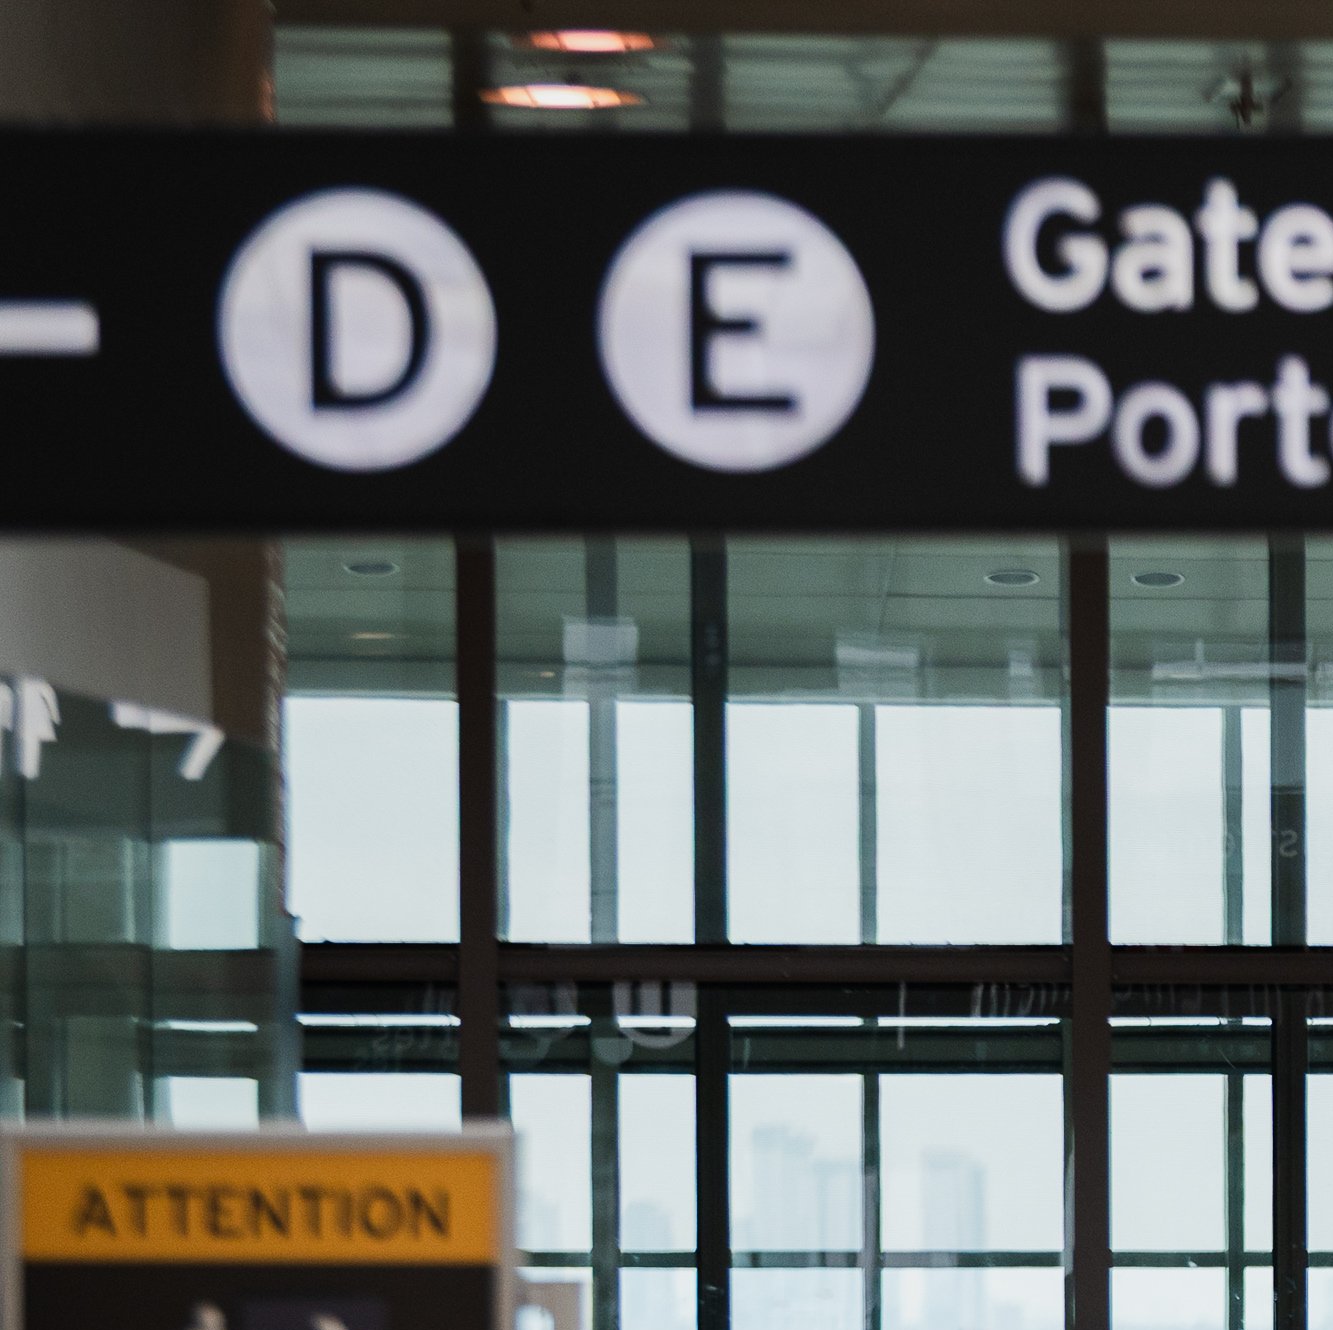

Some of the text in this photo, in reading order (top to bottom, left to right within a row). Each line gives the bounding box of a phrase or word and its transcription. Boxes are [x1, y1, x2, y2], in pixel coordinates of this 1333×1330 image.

[309, 247, 801, 412] D E
[72, 1182, 453, 1240] ATTENTION
